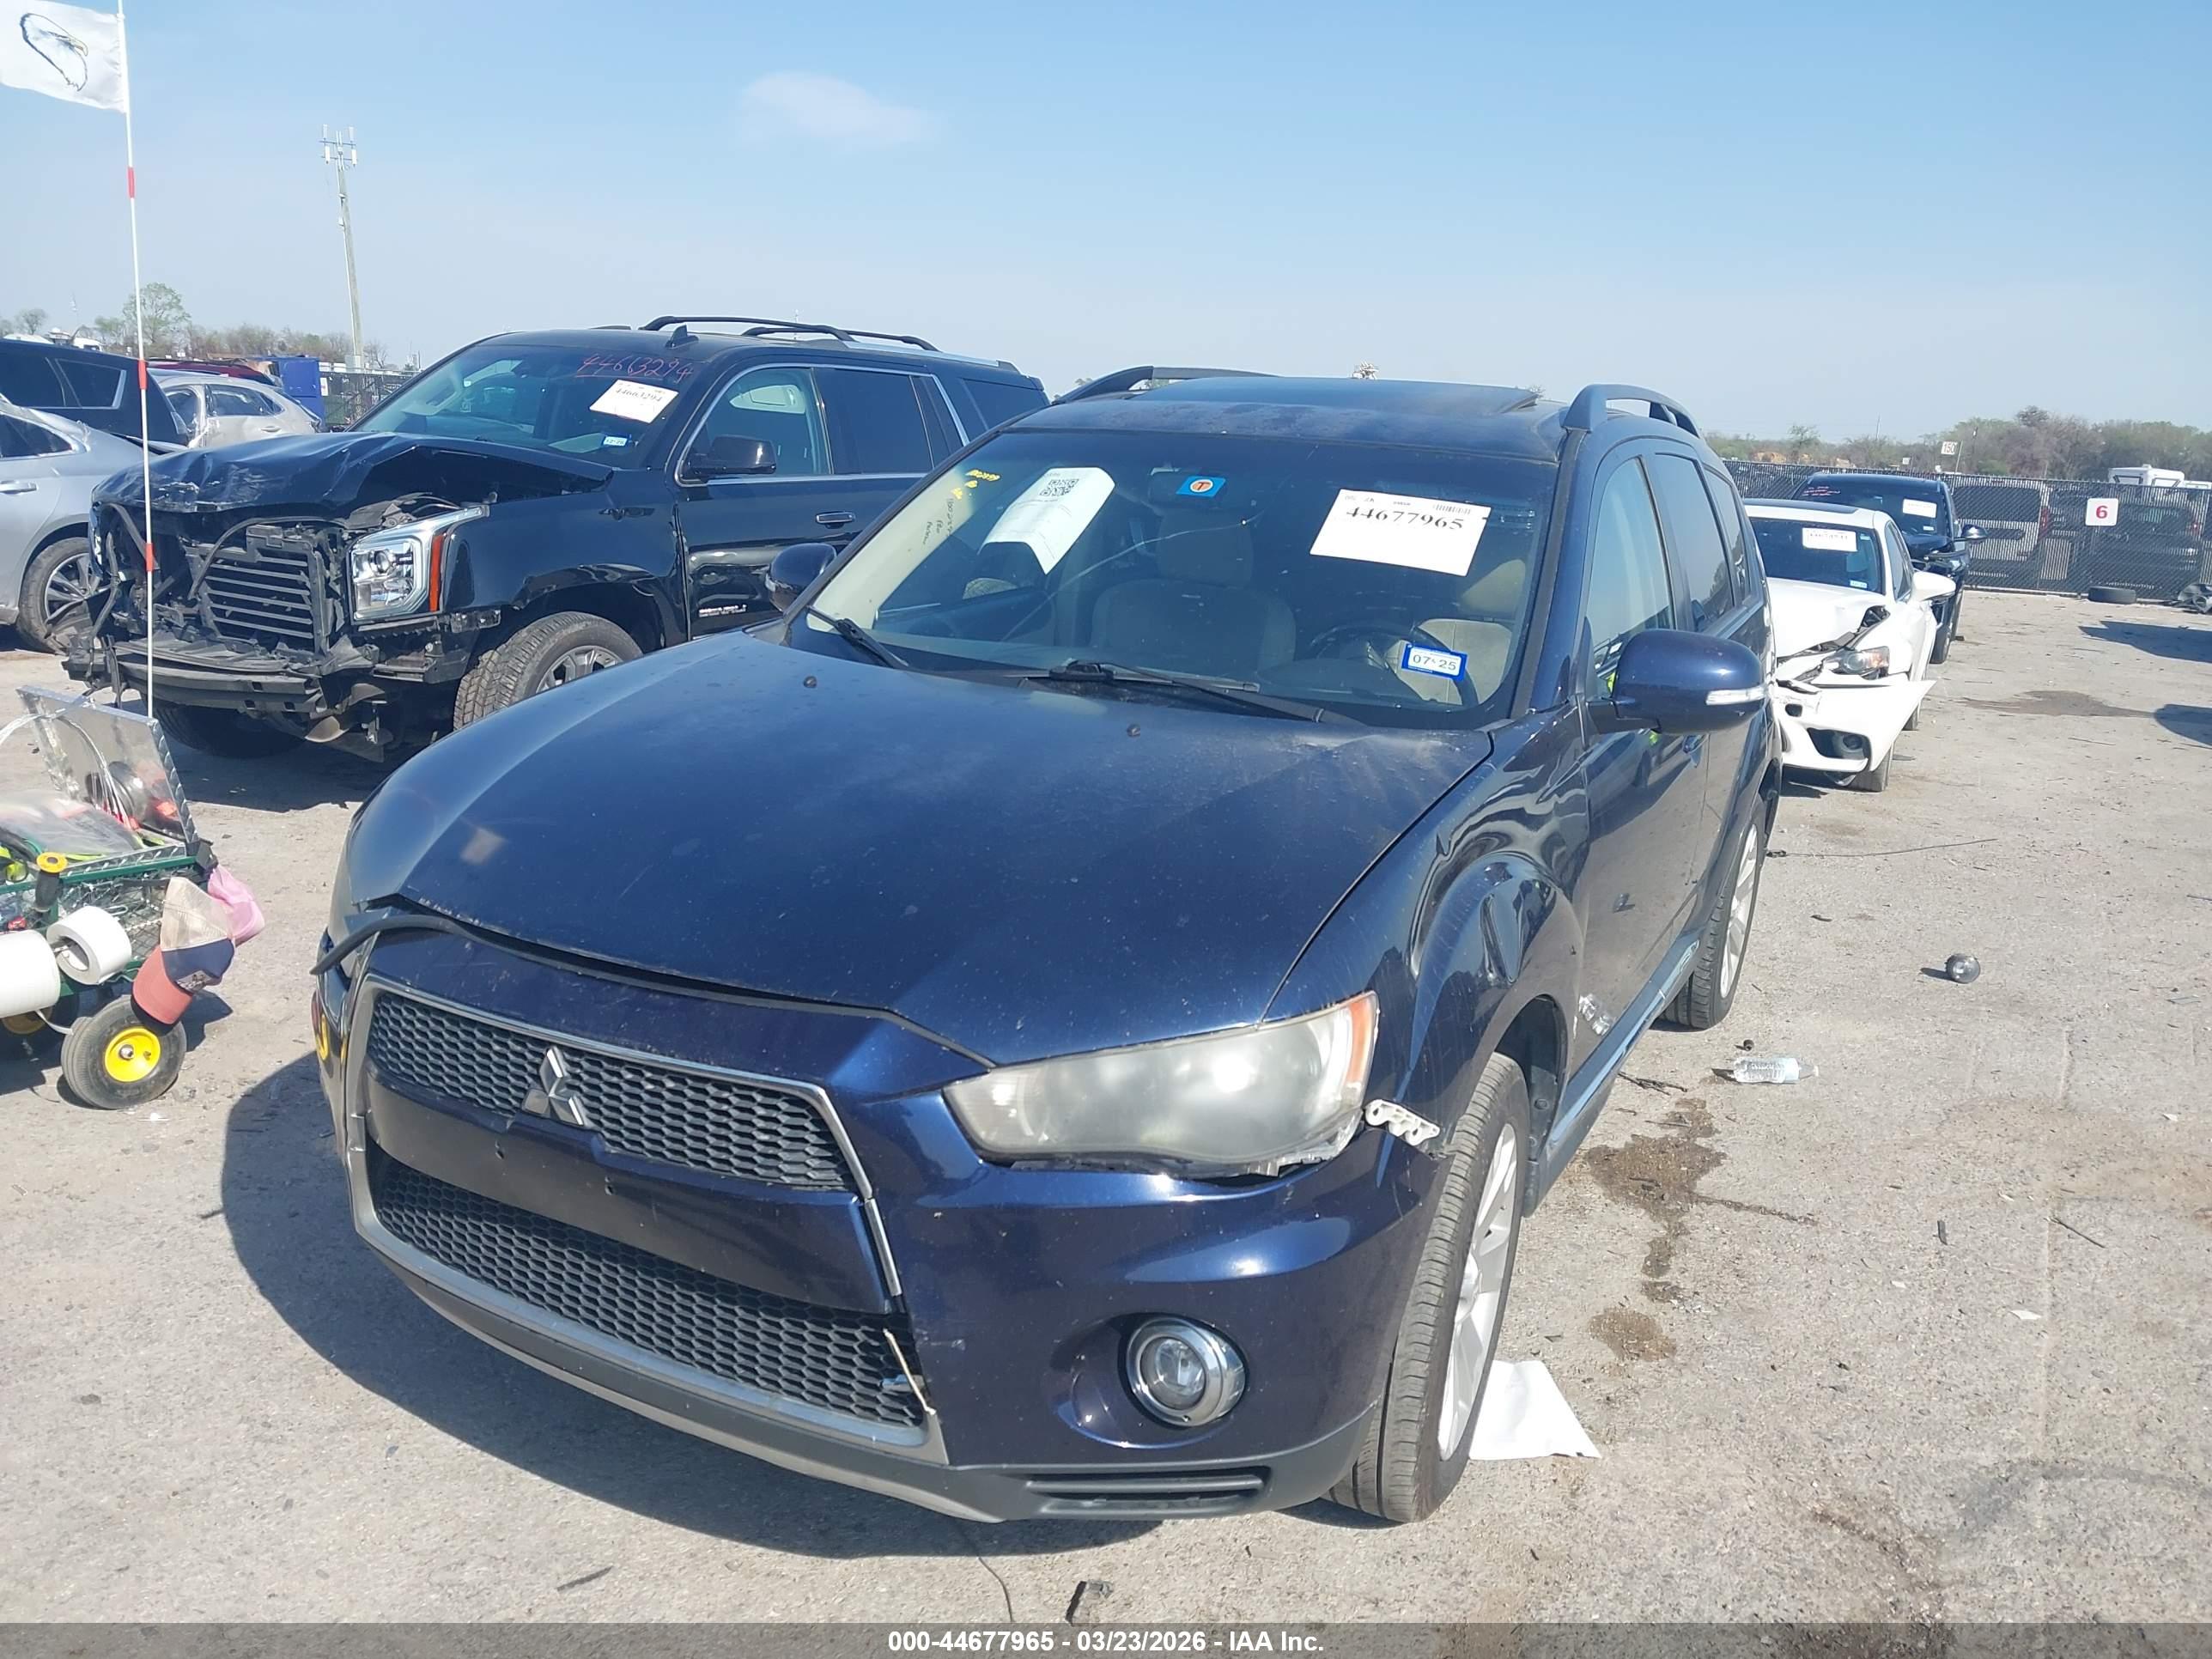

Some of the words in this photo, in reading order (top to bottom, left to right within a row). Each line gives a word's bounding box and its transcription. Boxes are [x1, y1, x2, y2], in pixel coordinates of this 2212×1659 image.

[576, 353, 694, 383] 44663294
[1346, 507, 1464, 530] 44677965
[2095, 505, 2108, 520] 6
[1413, 654, 1457, 671] 07-25
